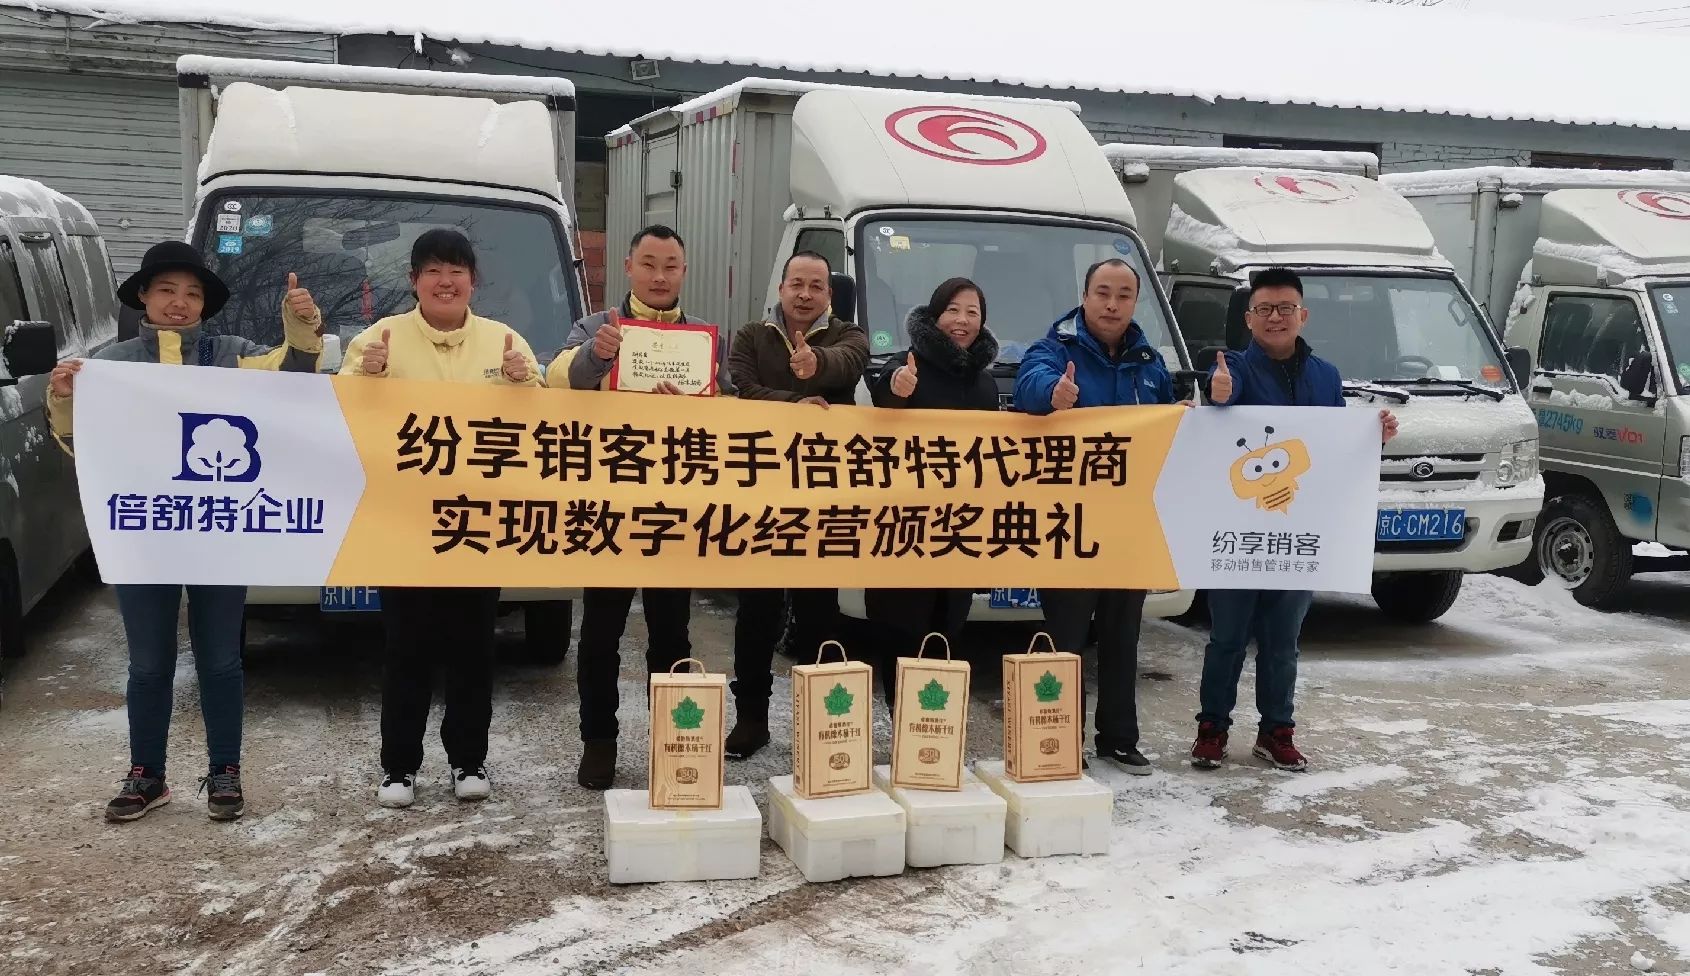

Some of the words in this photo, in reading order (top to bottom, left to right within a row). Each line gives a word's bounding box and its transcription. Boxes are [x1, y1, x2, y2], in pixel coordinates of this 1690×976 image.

[397, 412, 1132, 488] 纷享销客携手倍舒特代理商
[107, 486, 325, 534] 倍舒特企业
[431, 494, 1100, 560] 实现数字化经营颁奖典礼
[1211, 558, 1320, 573] 移动销售管理专家
[1212, 530, 1321, 556] 纷享销客
